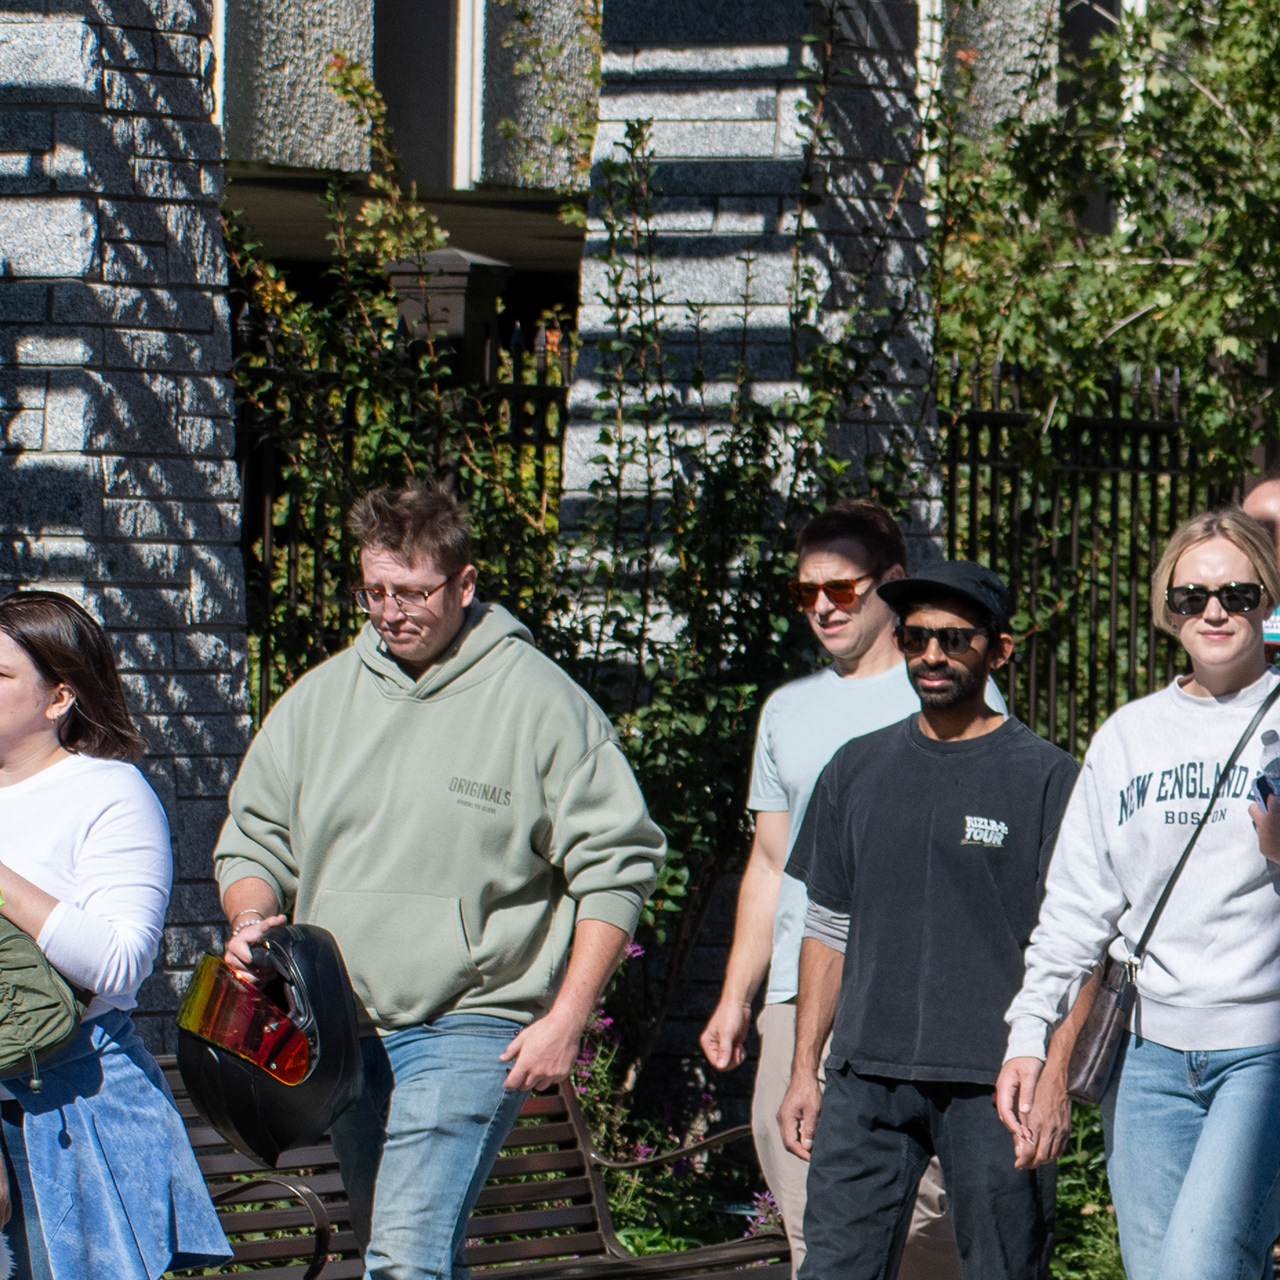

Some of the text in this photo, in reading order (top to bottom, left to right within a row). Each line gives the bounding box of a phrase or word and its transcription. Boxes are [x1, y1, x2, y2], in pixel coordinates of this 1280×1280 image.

[448, 776, 512, 807] ORIGINALS
[1118, 772, 1154, 826] NEW
[1164, 808, 1228, 826] BOSON
[965, 827, 1004, 845] TOUR
